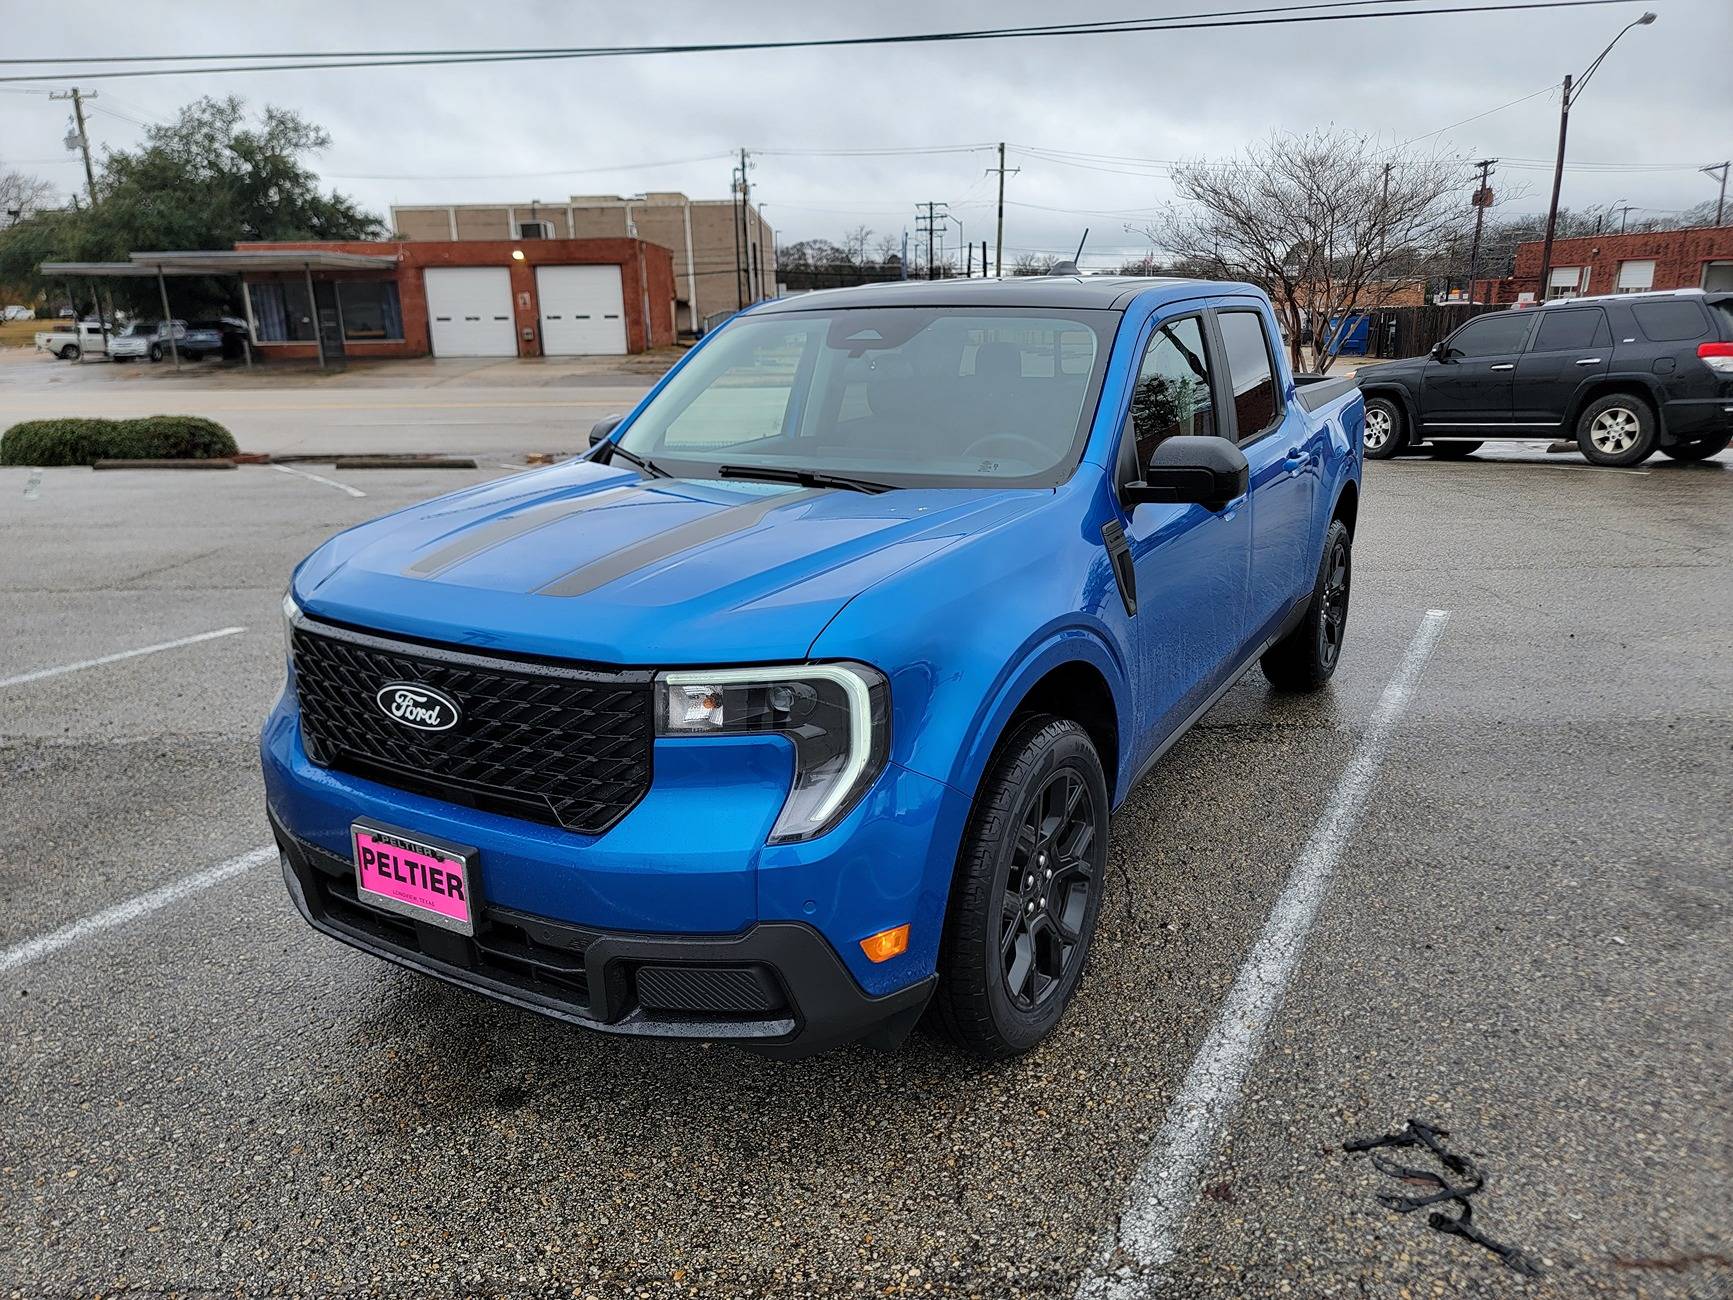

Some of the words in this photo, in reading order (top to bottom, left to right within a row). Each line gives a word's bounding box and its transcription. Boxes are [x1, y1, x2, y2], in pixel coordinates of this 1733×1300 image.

[391, 690, 441, 726] Ford
[381, 835, 433, 858] PELTIER
[361, 846, 465, 902] PELTIER
